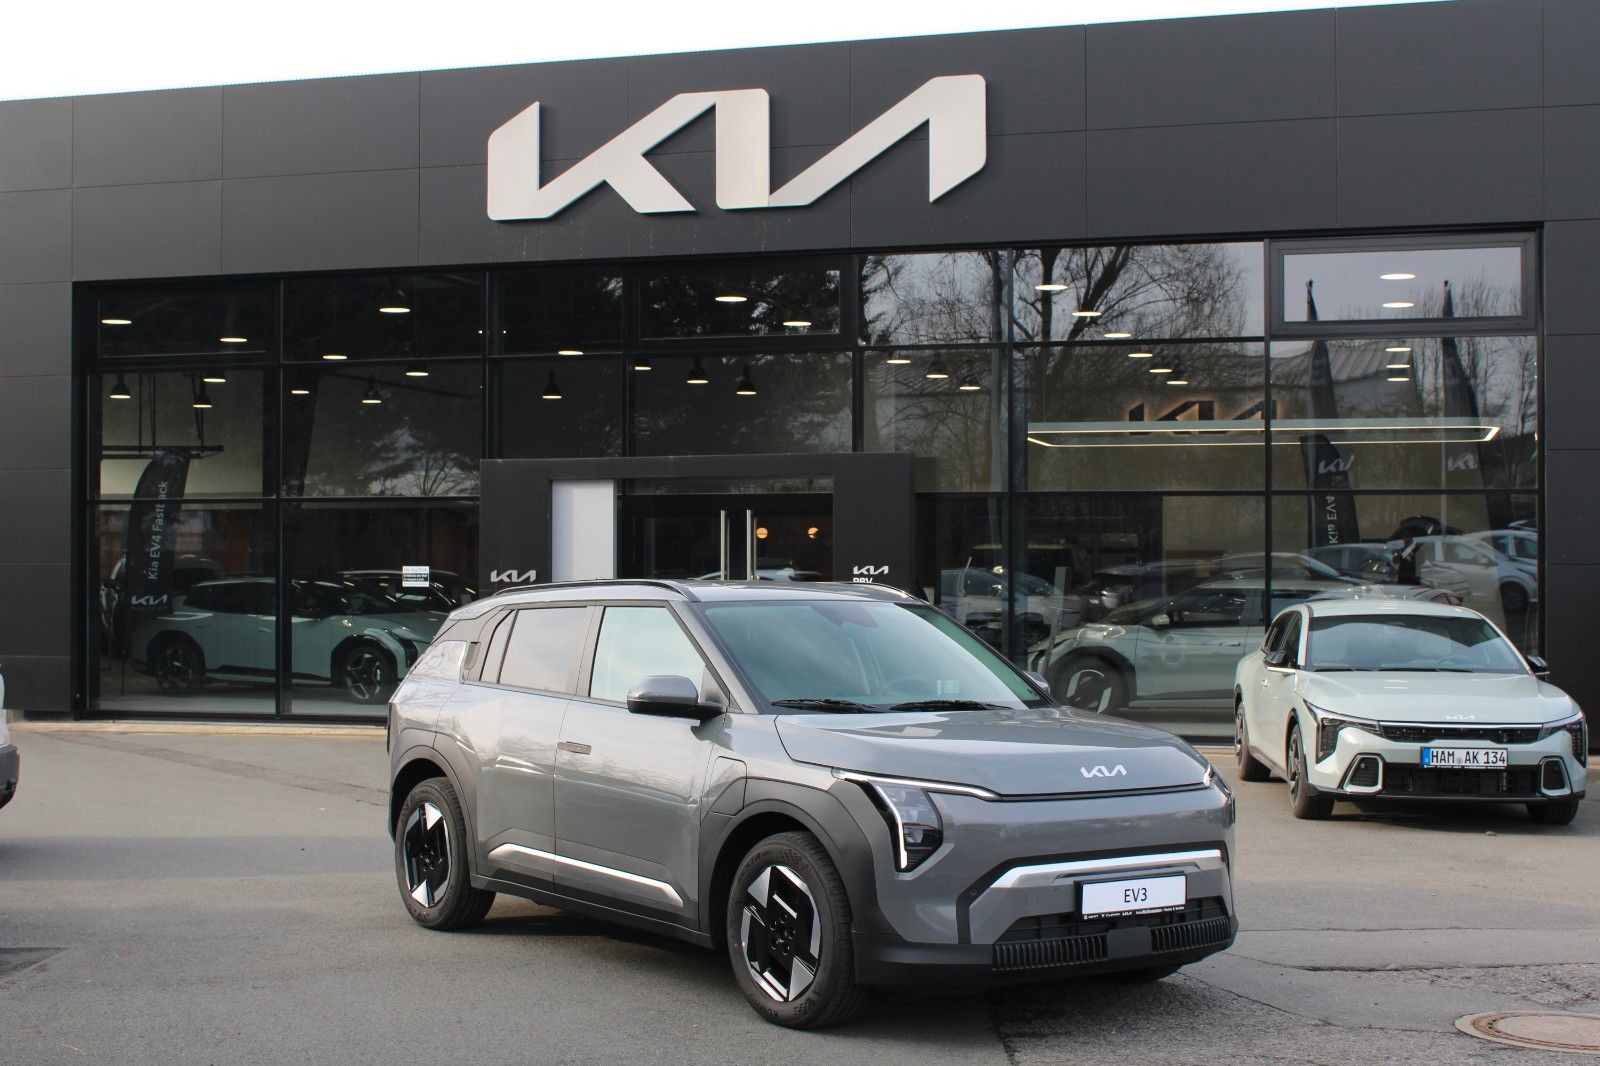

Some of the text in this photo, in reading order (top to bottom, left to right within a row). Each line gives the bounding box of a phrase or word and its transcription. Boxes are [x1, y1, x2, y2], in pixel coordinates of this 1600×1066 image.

[488, 74, 986, 220] KIA
[150, 535, 162, 559] EV4
[148, 561, 159, 580] Kia
[490, 569, 537, 583] KIA
[853, 565, 889, 575] KIA
[131, 593, 168, 605] KIA
[1431, 750, 1506, 764] HAM AK 134
[1080, 764, 1127, 778] KIA
[1124, 887, 1148, 903] EV3
